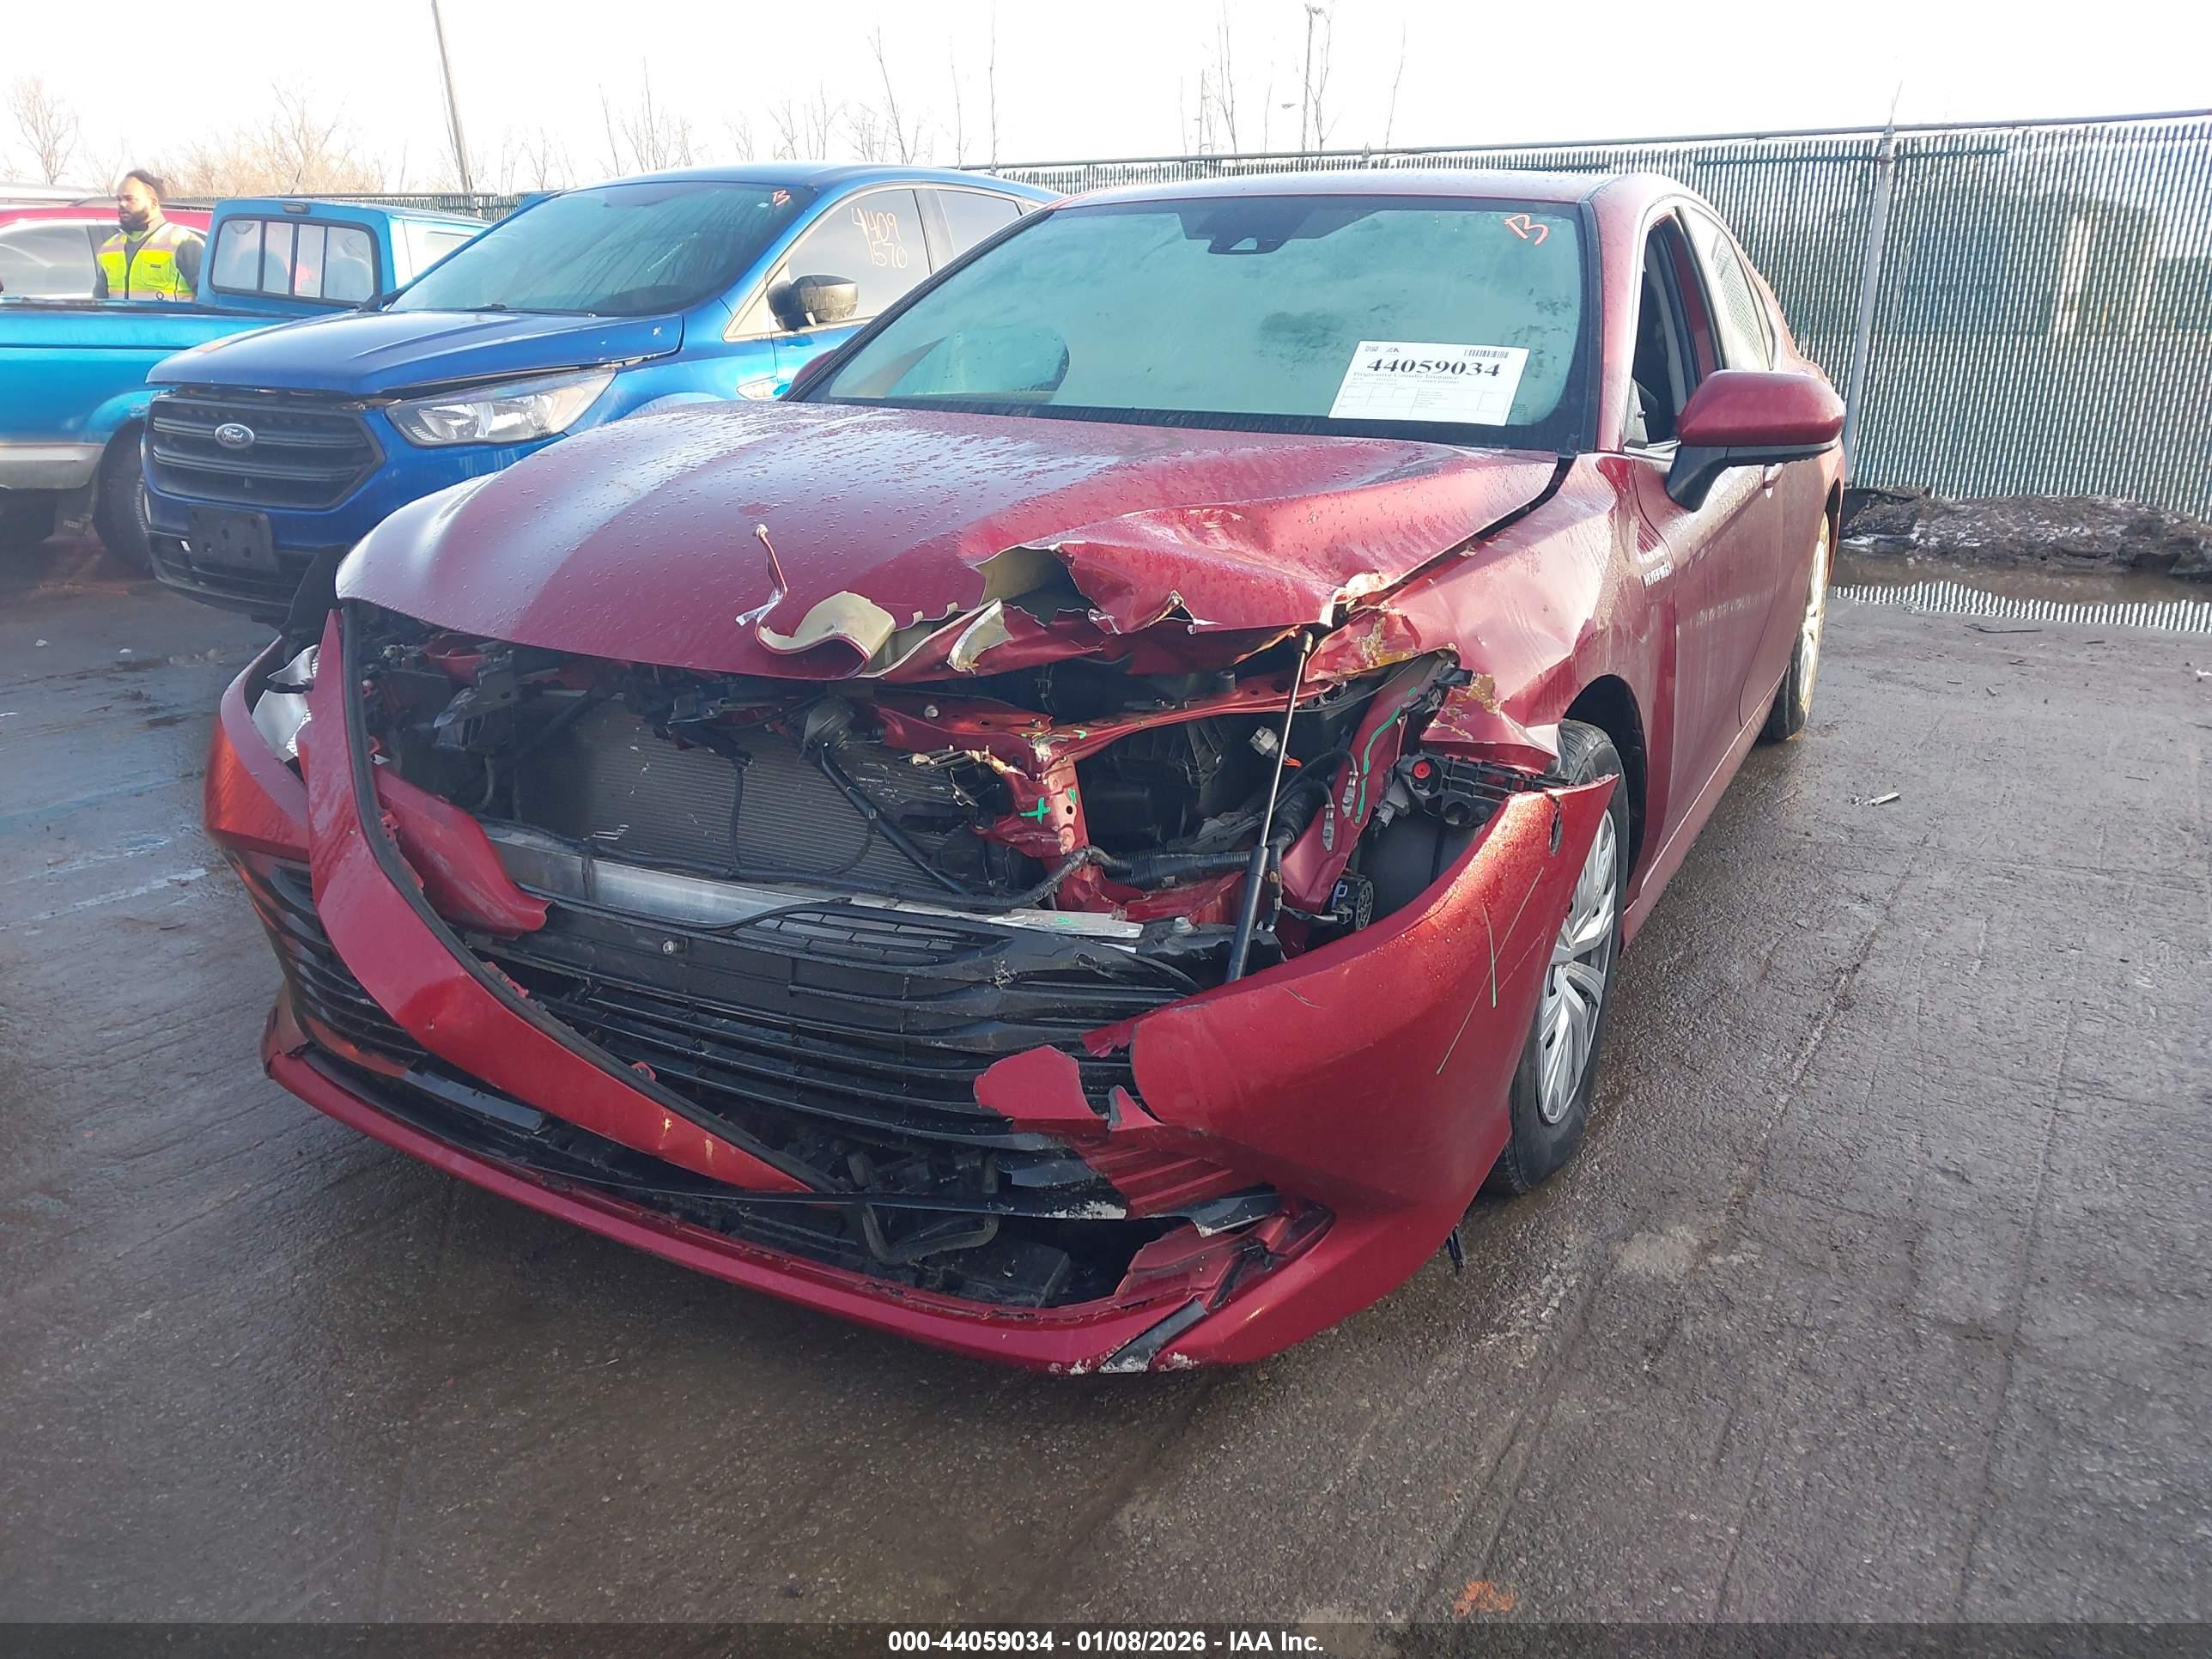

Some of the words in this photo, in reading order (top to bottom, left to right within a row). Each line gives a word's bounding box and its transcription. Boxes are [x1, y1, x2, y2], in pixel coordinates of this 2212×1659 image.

[851, 207, 901, 241] 4409
[1366, 358, 1501, 377] 44059034
[222, 428, 244, 442] Ford
